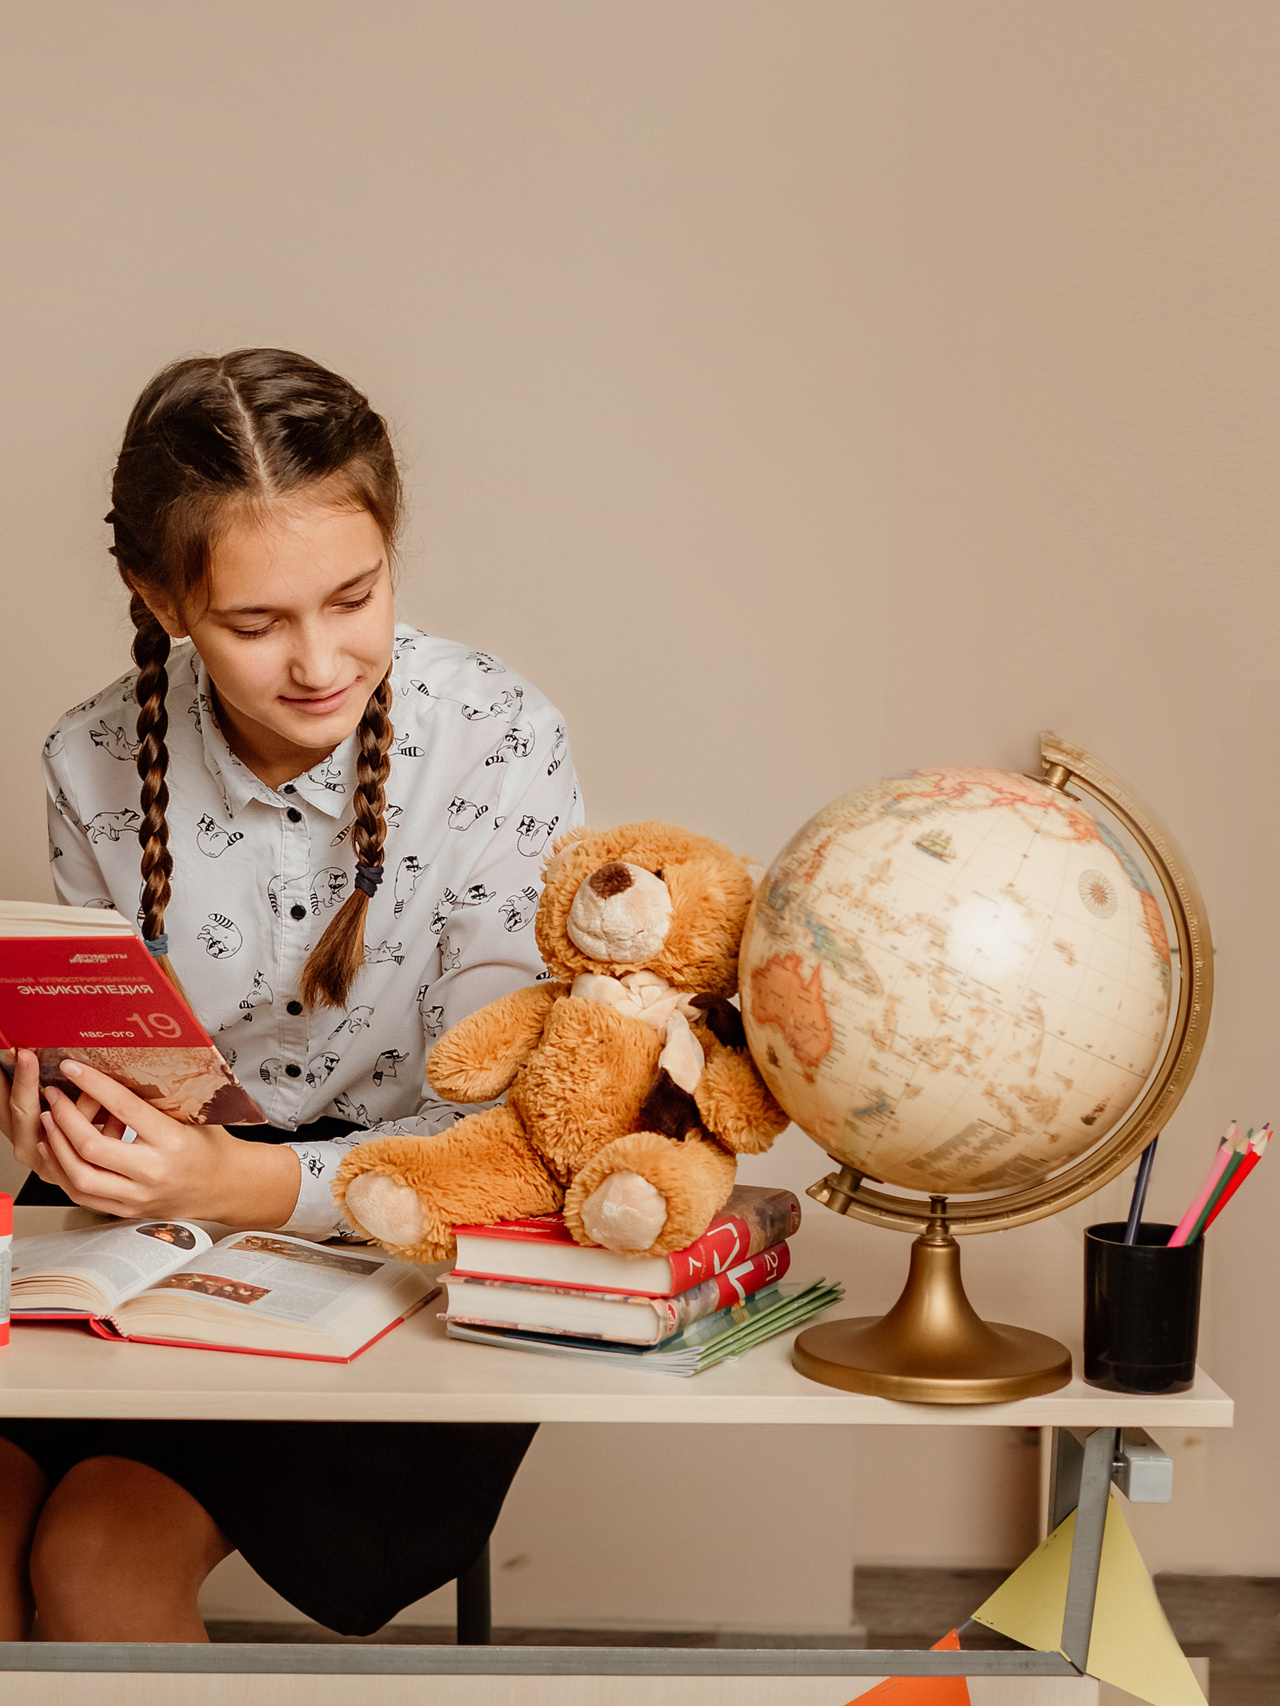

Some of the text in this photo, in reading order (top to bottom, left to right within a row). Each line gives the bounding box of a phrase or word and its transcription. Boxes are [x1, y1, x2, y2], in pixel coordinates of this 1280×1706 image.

[16, 984, 154, 996] ЭНЦИКЛОПЕДИЯ
[126, 1012, 182, 1039] 19
[764, 1251, 779, 1282] 21
